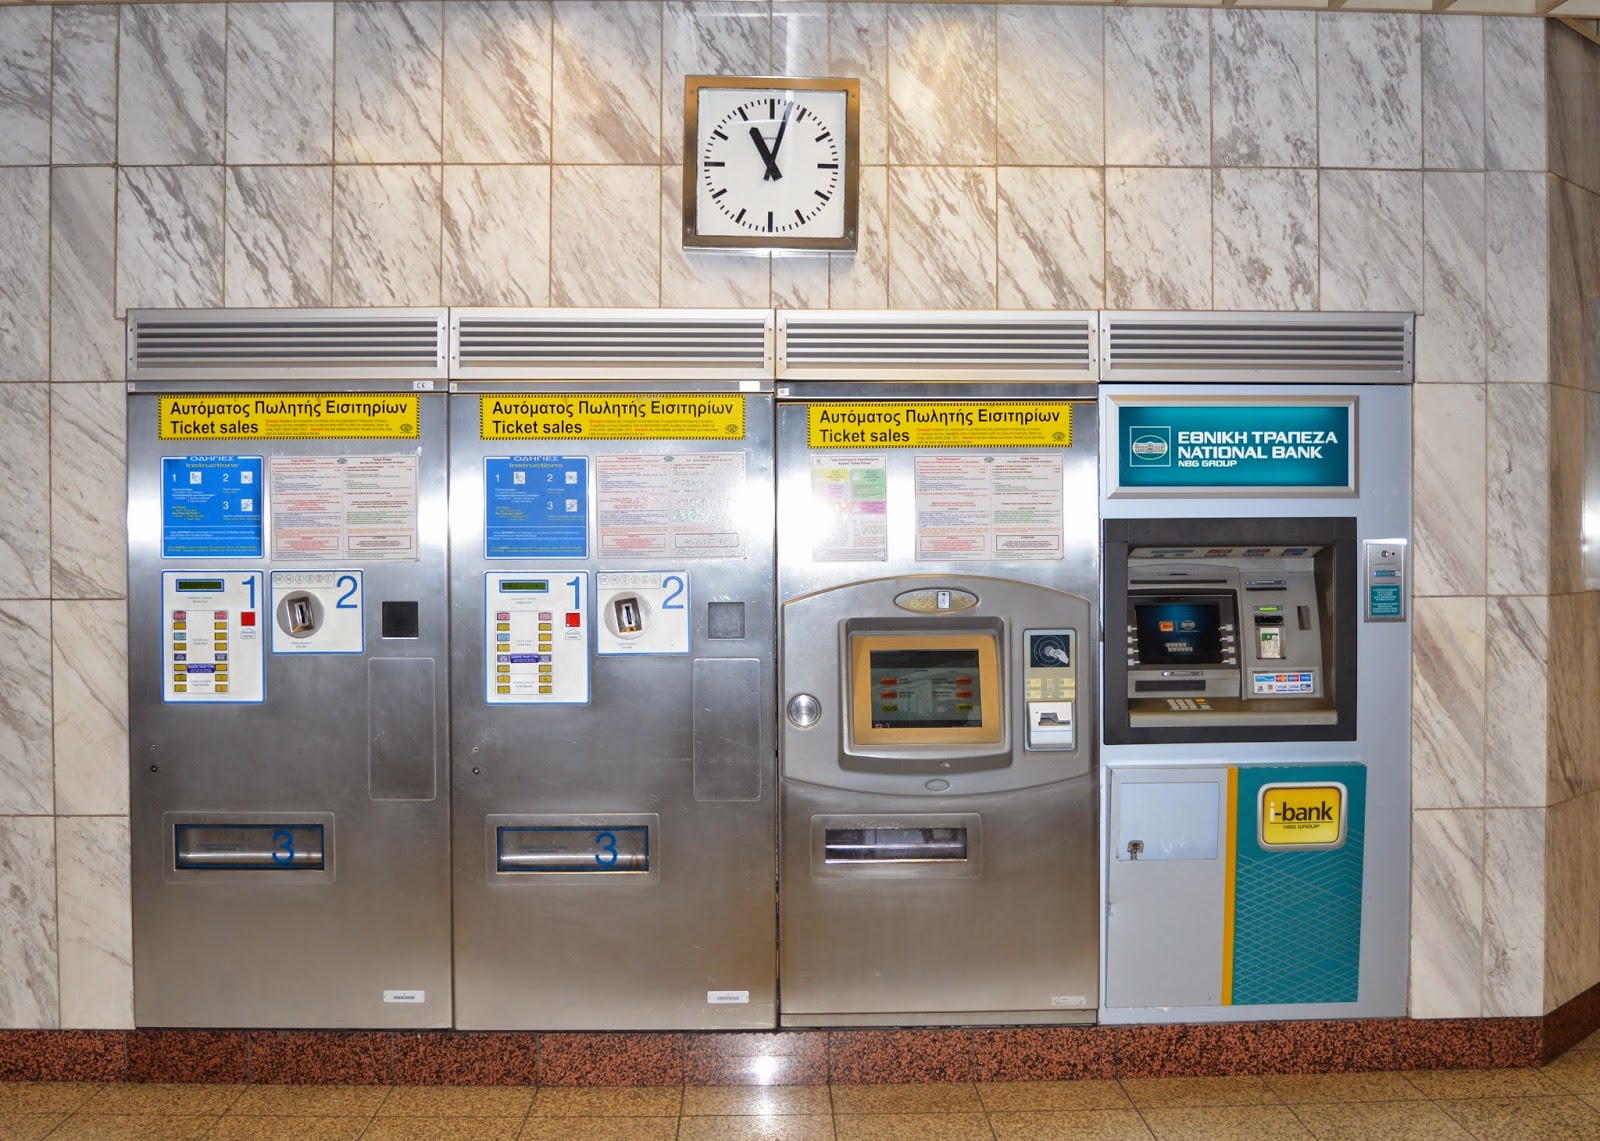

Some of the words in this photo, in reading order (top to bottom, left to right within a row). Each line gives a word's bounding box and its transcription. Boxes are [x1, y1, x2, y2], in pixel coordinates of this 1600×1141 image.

[170, 401, 250, 417] Αυτόματος
[255, 400, 321, 417] Πωλητής
[326, 400, 408, 416] Εισιτηρίων
[492, 401, 574, 417] Αυτόματος
[578, 400, 646, 417] Πωλητής
[652, 400, 733, 417] Εισιτηρίων
[819, 410, 901, 426] Αυτόματος
[906, 409, 973, 426] Πωλητής
[978, 409, 1060, 425] Εισιτηρίων
[170, 420, 215, 434] Ticket
[219, 420, 259, 434] sales
[492, 420, 538, 434] Ticket
[543, 420, 582, 434] sales
[819, 429, 866, 443] Ticket
[870, 428, 910, 443] sales
[1178, 431, 1248, 444] ΕΘΝΙΚΗ
[1251, 431, 1338, 444] ΤΡΑΠΕΖΑ
[1178, 446, 1268, 459] NATIONAL
[1271, 446, 1323, 459] BANK
[172, 473, 176, 482] 1
[222, 473, 229, 482] 2
[495, 473, 500, 482] 1
[547, 473, 554, 482] 2
[222, 501, 229, 510] 3
[547, 501, 554, 510] 3
[241, 575, 255, 609] 1
[336, 575, 358, 609] 2
[566, 576, 580, 610] 1
[662, 575, 684, 609] 2
[1269, 801, 1333, 822] i-bank
[271, 830, 295, 865] 3
[594, 831, 619, 867] 3
